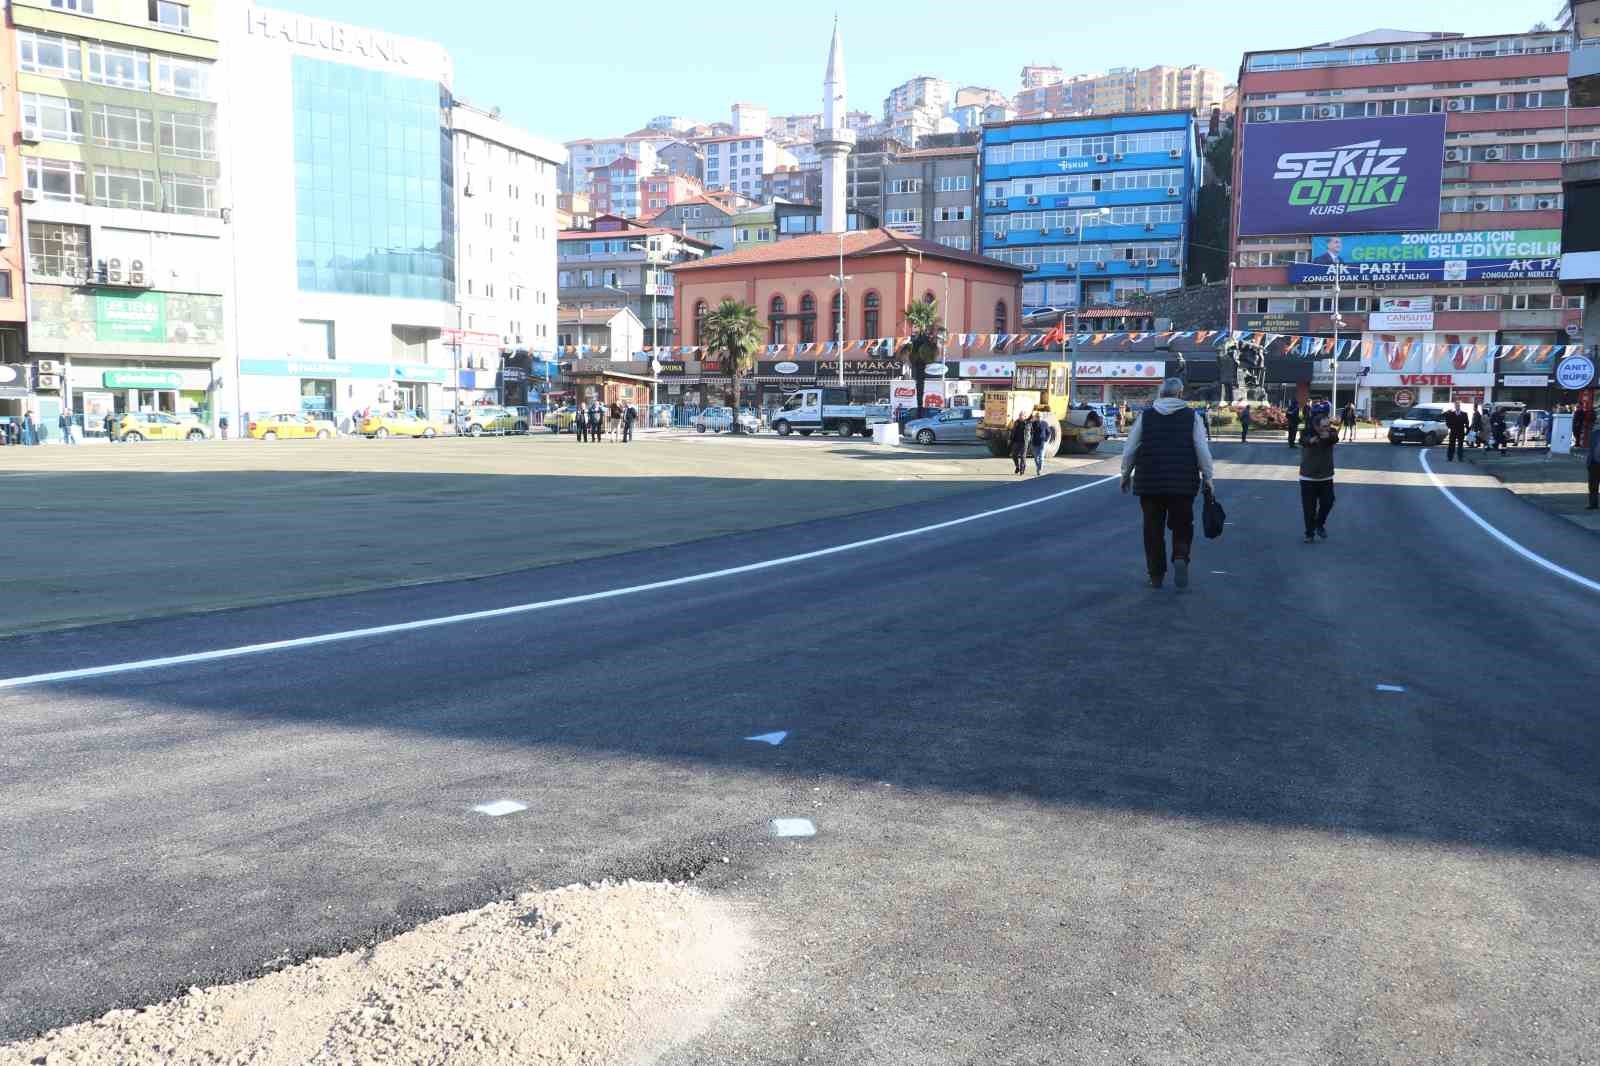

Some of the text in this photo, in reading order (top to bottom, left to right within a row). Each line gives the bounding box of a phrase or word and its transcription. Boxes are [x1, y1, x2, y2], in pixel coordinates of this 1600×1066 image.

[1309, 204, 1346, 217] KURS
[1401, 231, 1482, 245] ZONGULDAK
[1326, 263, 1349, 275] AK
[1508, 259, 1534, 271] AK
[1398, 373, 1453, 386] VESTEL
